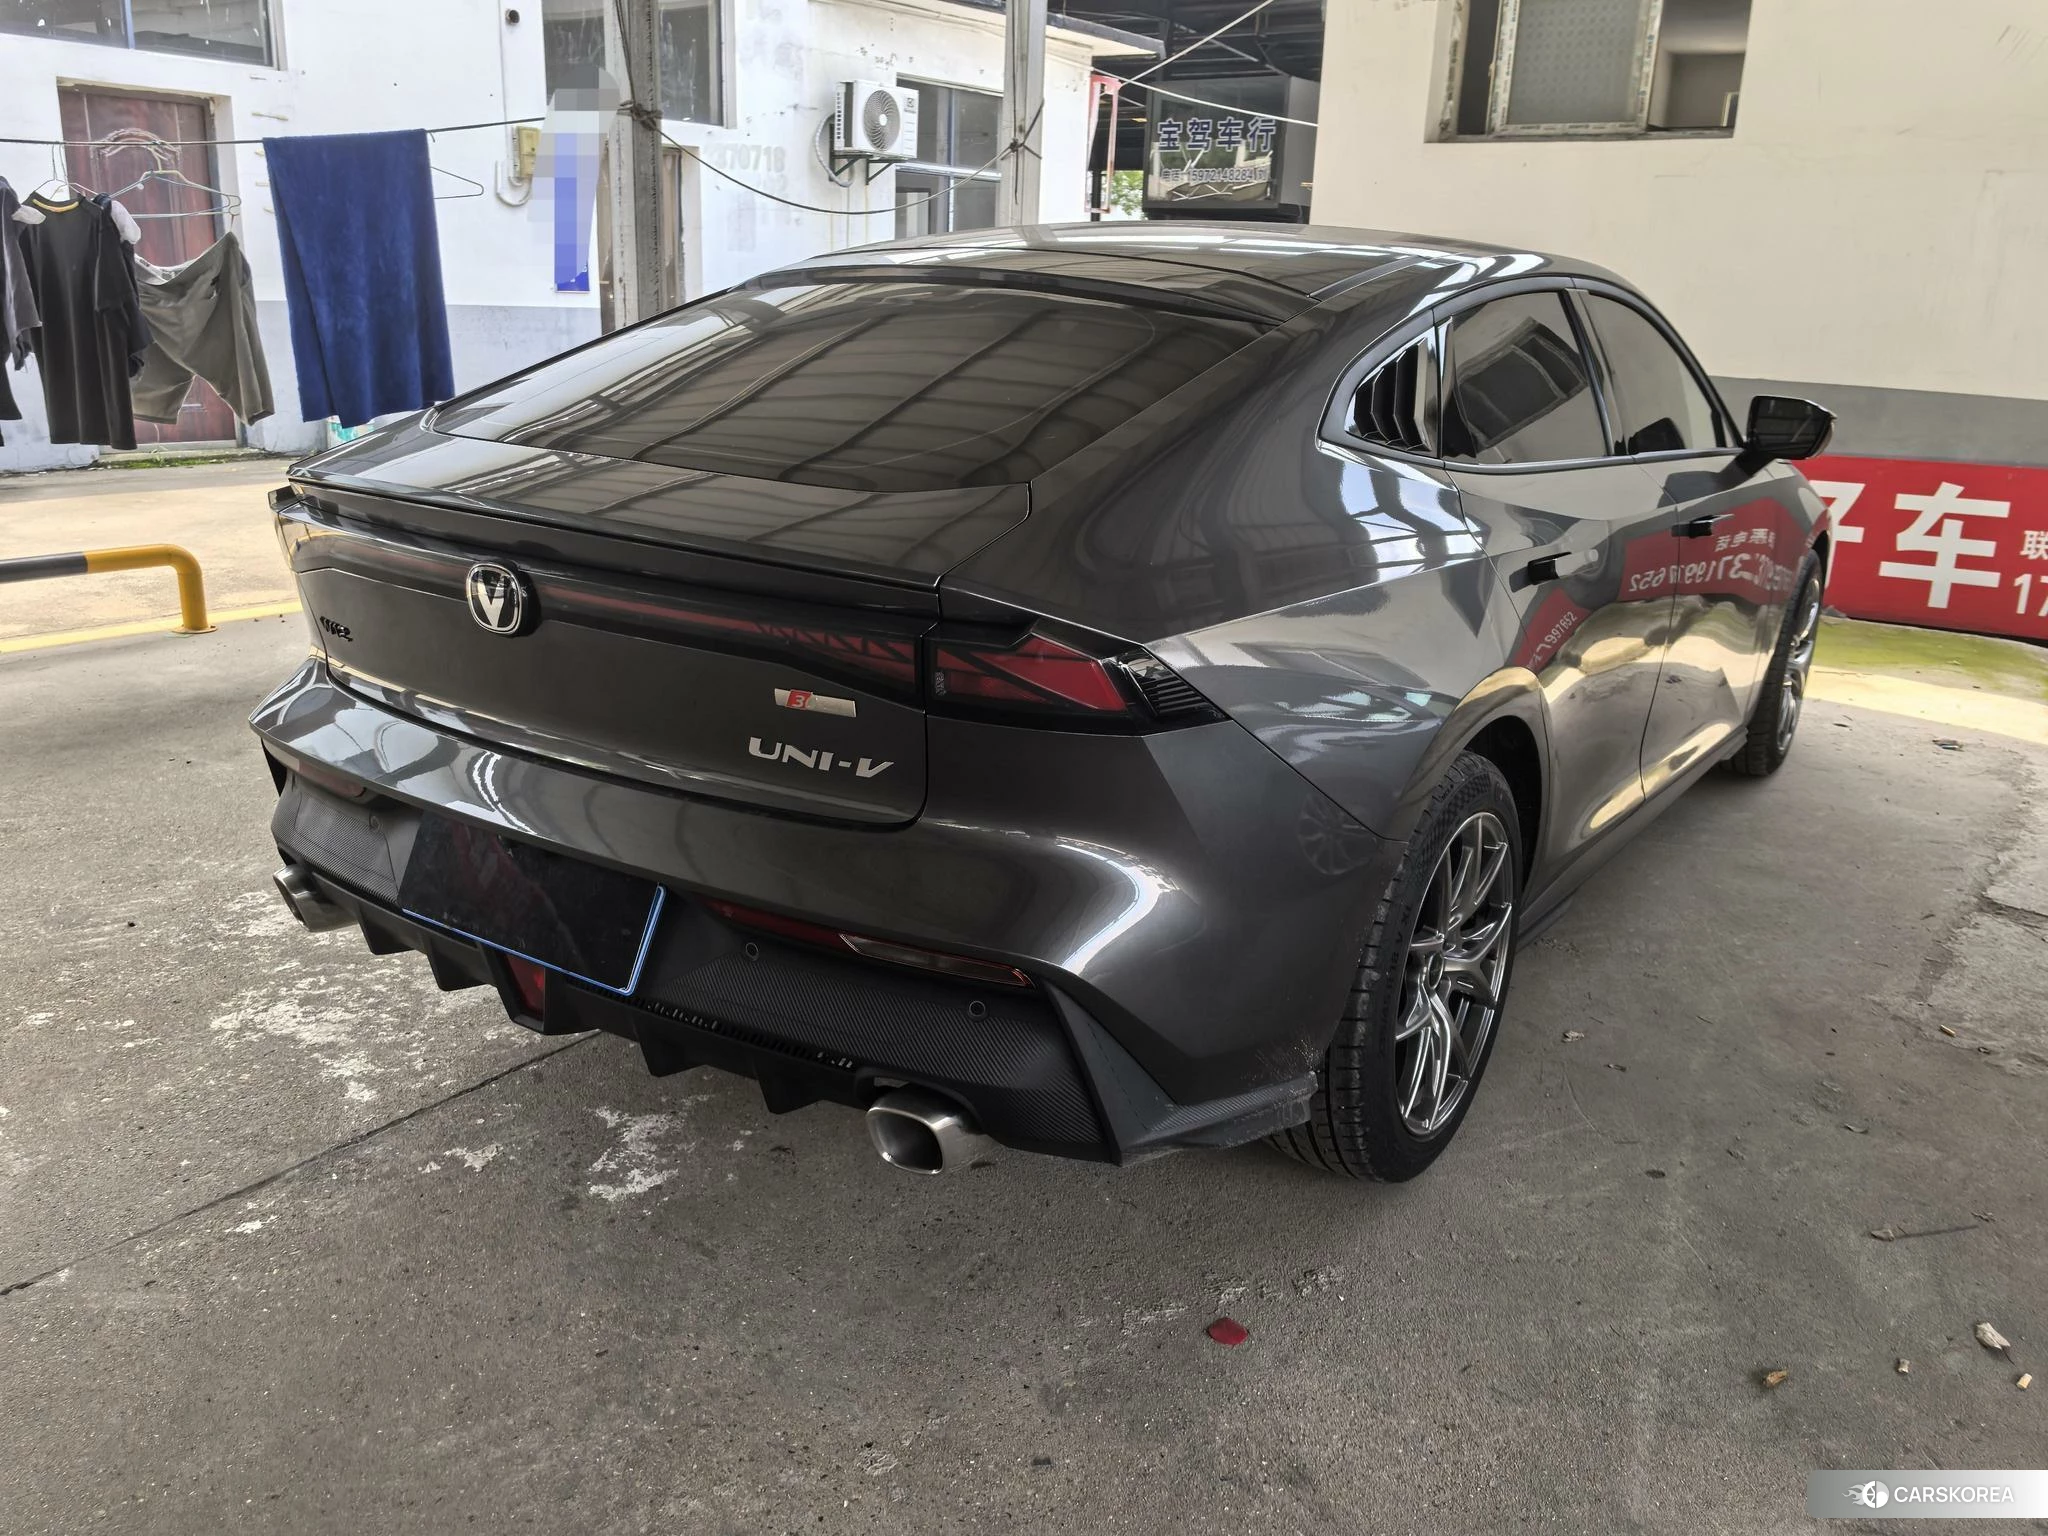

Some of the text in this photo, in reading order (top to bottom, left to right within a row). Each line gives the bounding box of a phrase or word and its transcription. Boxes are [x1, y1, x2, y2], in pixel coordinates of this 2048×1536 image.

[1157, 116, 1277, 153] 宝驾车行
[748, 736, 895, 779] UNI-V
